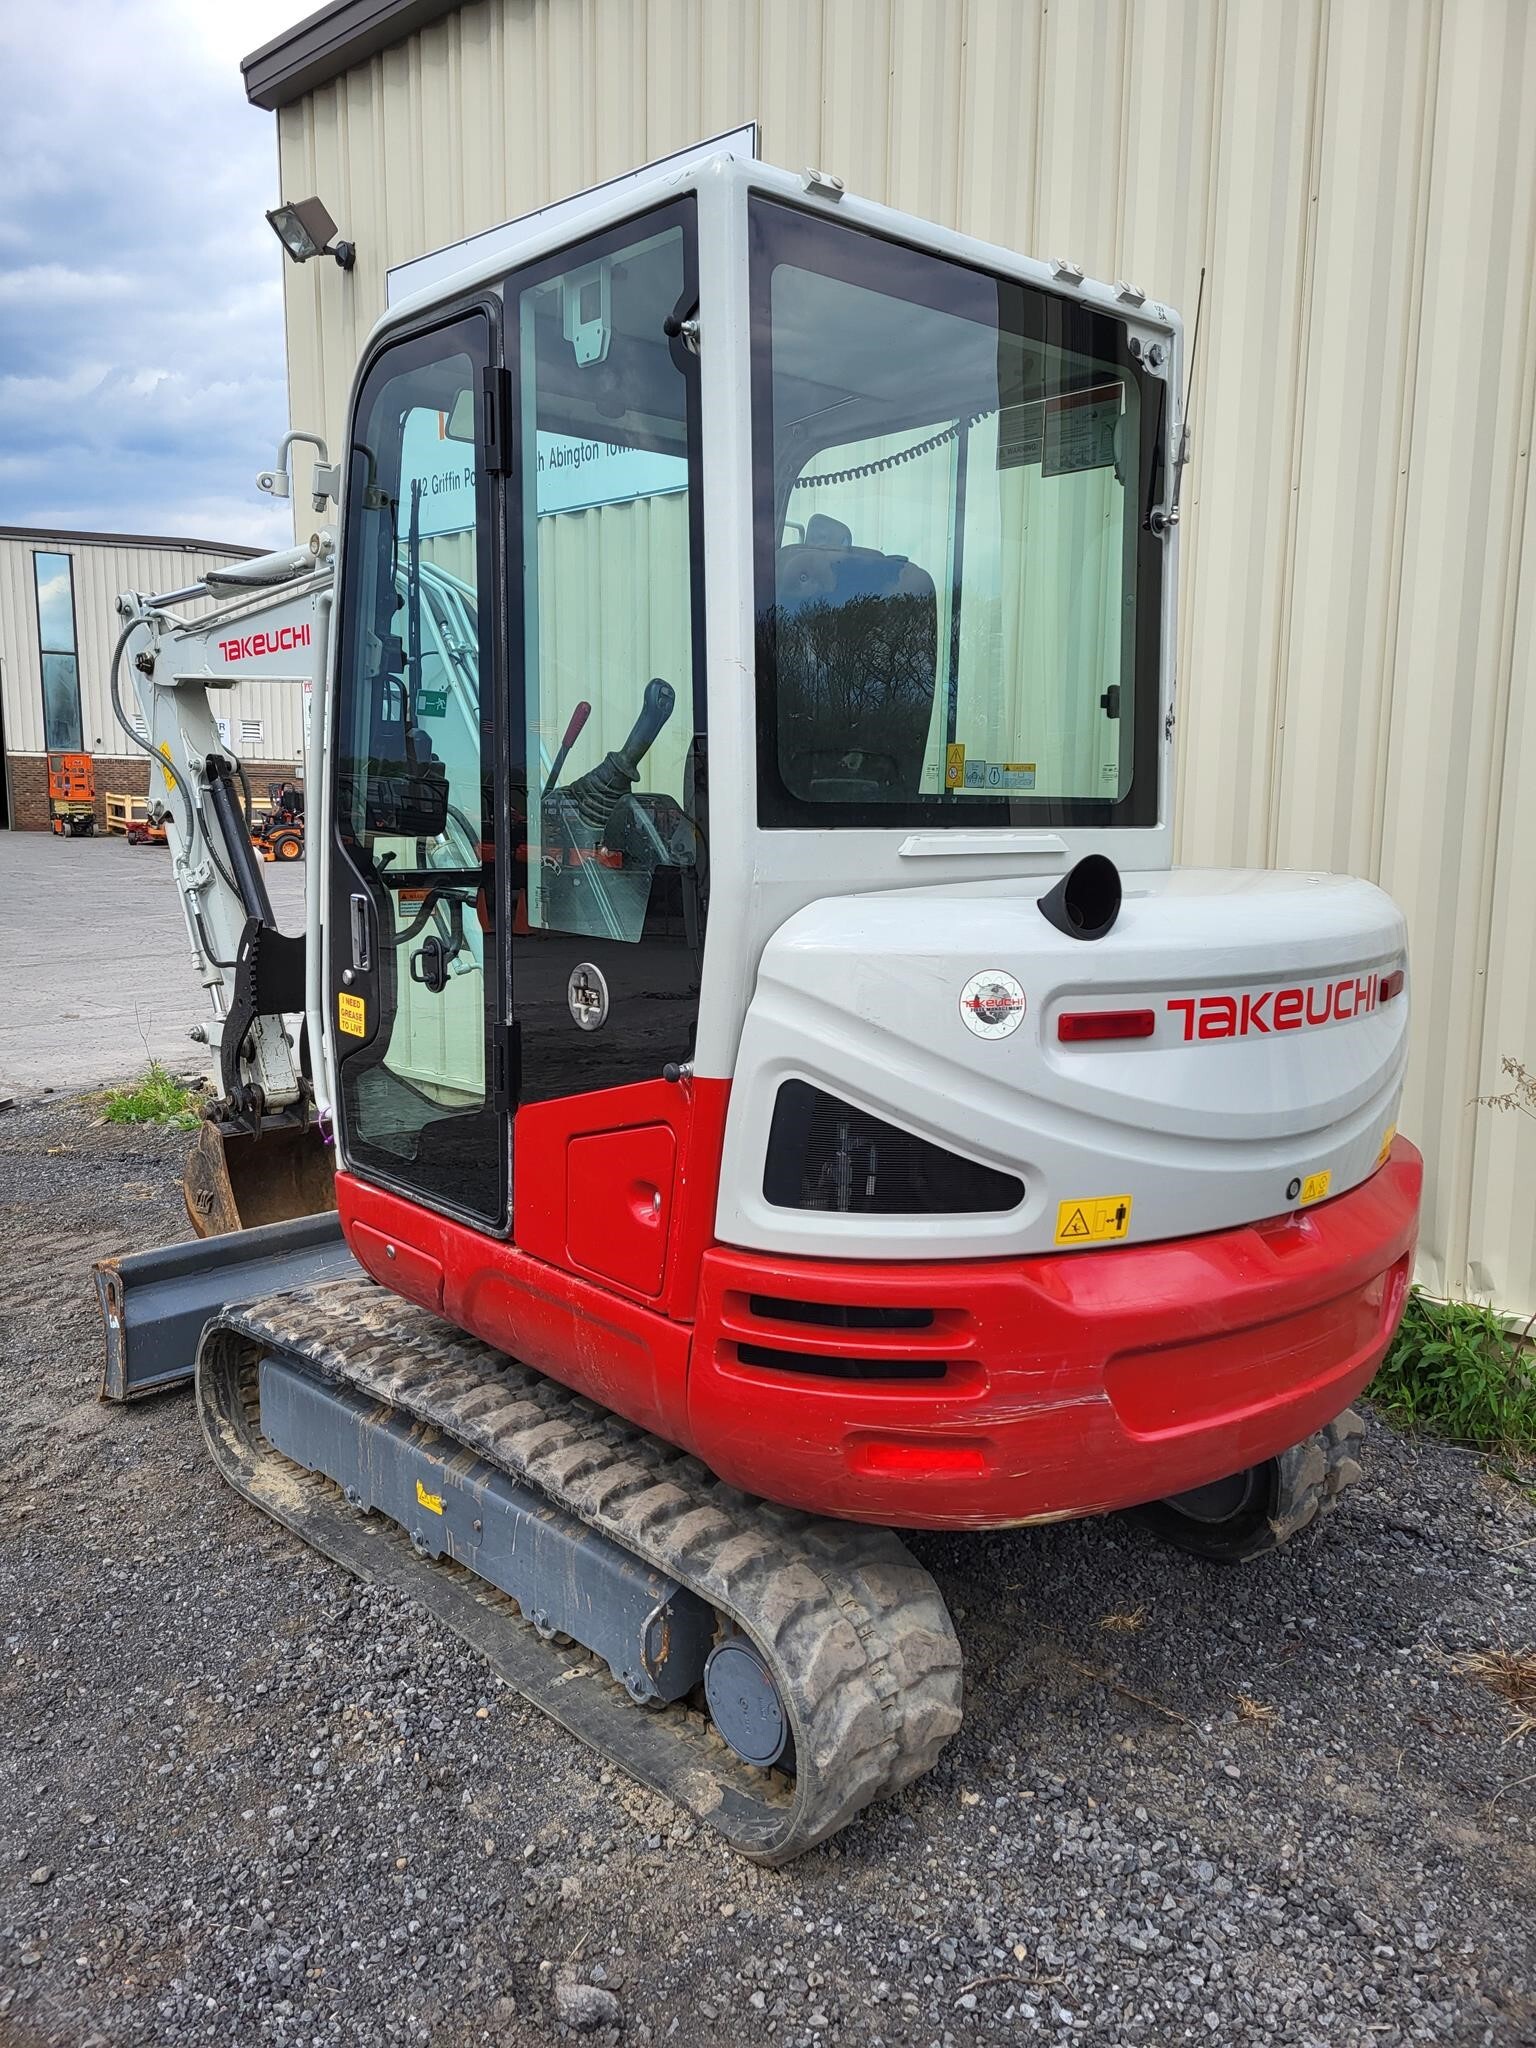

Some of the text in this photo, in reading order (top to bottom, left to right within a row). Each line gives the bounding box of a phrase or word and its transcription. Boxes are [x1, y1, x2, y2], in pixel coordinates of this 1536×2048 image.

[431, 474, 461, 495] Griffin
[549, 442, 600, 470] Abington
[219, 623, 311, 662] TAKEUCHI
[346, 998, 361, 1008] NEED
[962, 998, 1024, 1008] TAKEUCHI
[1167, 973, 1379, 1041] TAKEUCHI
[341, 1008, 362, 1021] GREASE
[342, 1021, 362, 1033] TO LIVE
